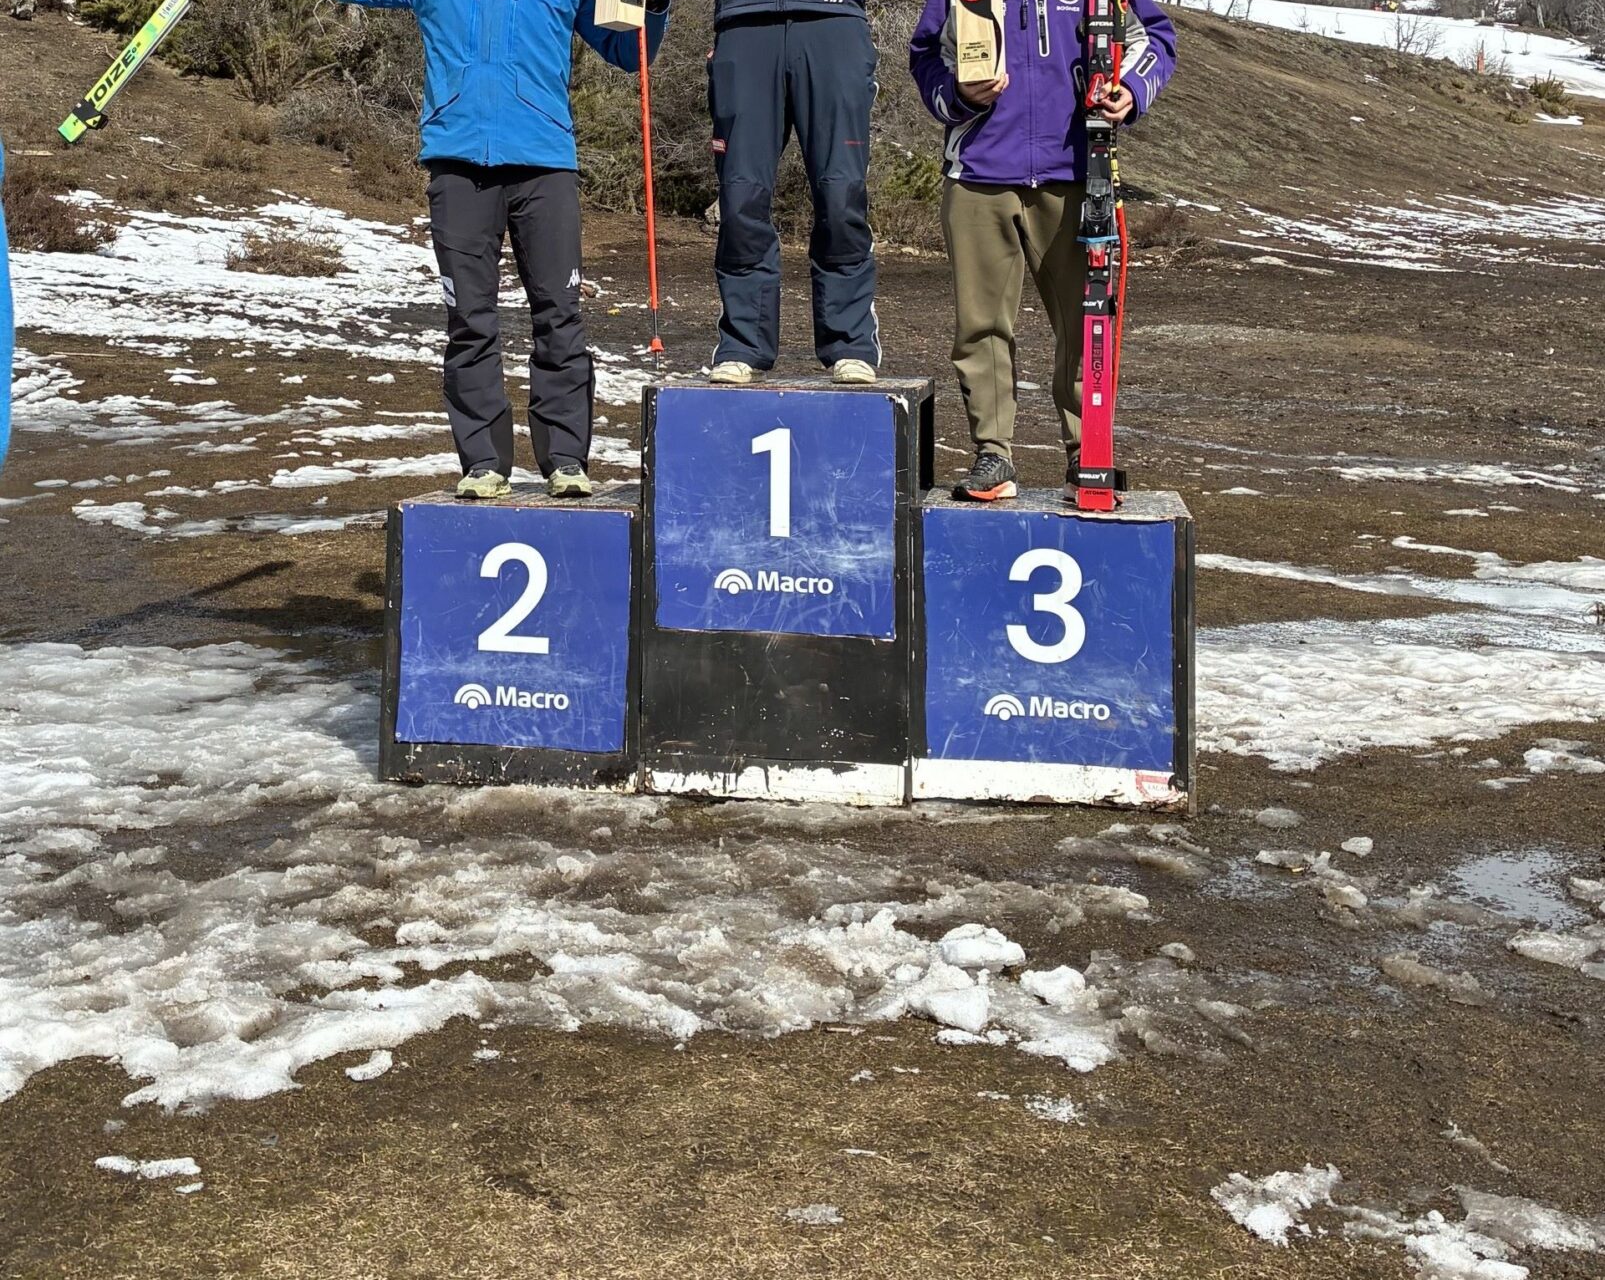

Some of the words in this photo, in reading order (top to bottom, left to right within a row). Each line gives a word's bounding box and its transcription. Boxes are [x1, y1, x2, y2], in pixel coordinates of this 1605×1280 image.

[752, 427, 791, 538] 1
[477, 542, 550, 655] 2
[757, 570, 834, 595] Macro
[1006, 548, 1087, 664] 3
[495, 685, 570, 710] Macro
[1029, 695, 1111, 721] Macro
